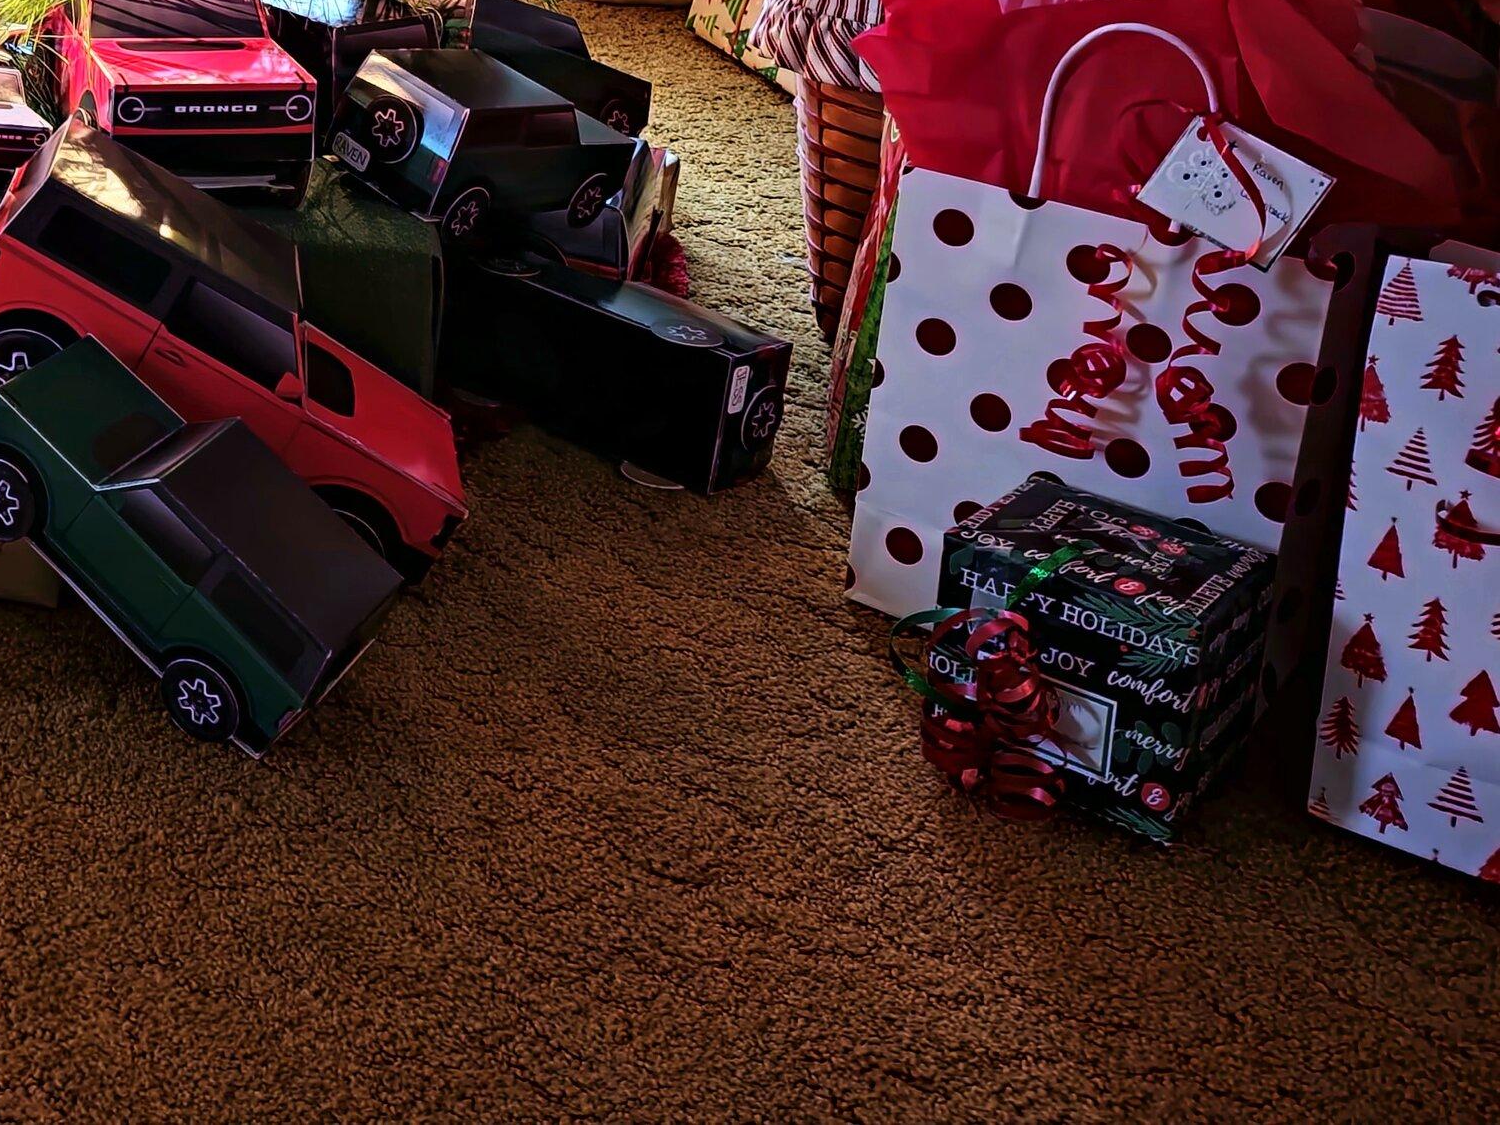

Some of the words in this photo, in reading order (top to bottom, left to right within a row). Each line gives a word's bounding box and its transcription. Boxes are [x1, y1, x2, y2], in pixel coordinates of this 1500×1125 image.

[173, 104, 258, 114] BRONCO
[334, 135, 368, 166] RAVEN
[731, 367, 749, 407] JESS
[1023, 547, 1118, 584] cofort
[1059, 596, 1202, 667] HOLIDAYS
[1040, 646, 1096, 679] JOY
[1105, 669, 1198, 714] comfort
